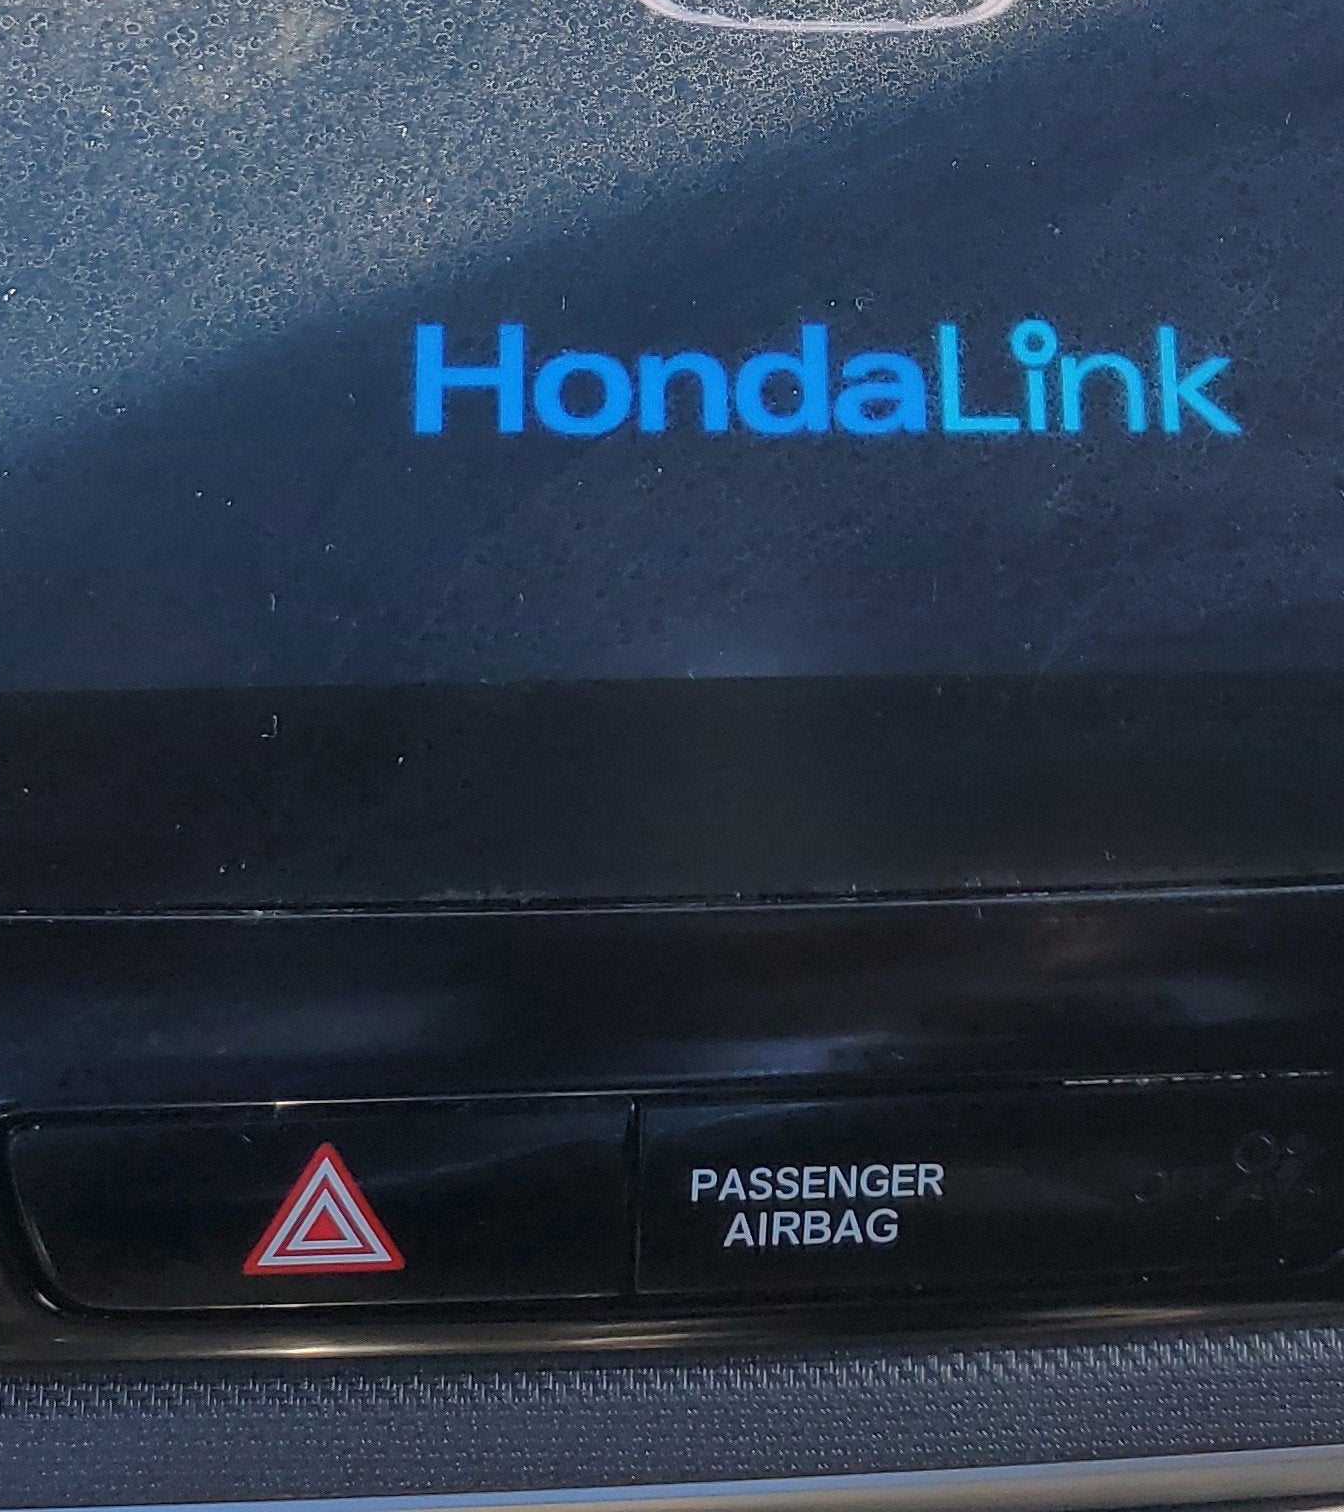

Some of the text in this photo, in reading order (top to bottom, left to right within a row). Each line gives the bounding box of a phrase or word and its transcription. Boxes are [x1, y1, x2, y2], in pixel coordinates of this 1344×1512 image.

[413, 318, 1243, 436] HondaLink
[690, 1163, 945, 1202] PASSENGER
[722, 1208, 899, 1248] AIRBAG
